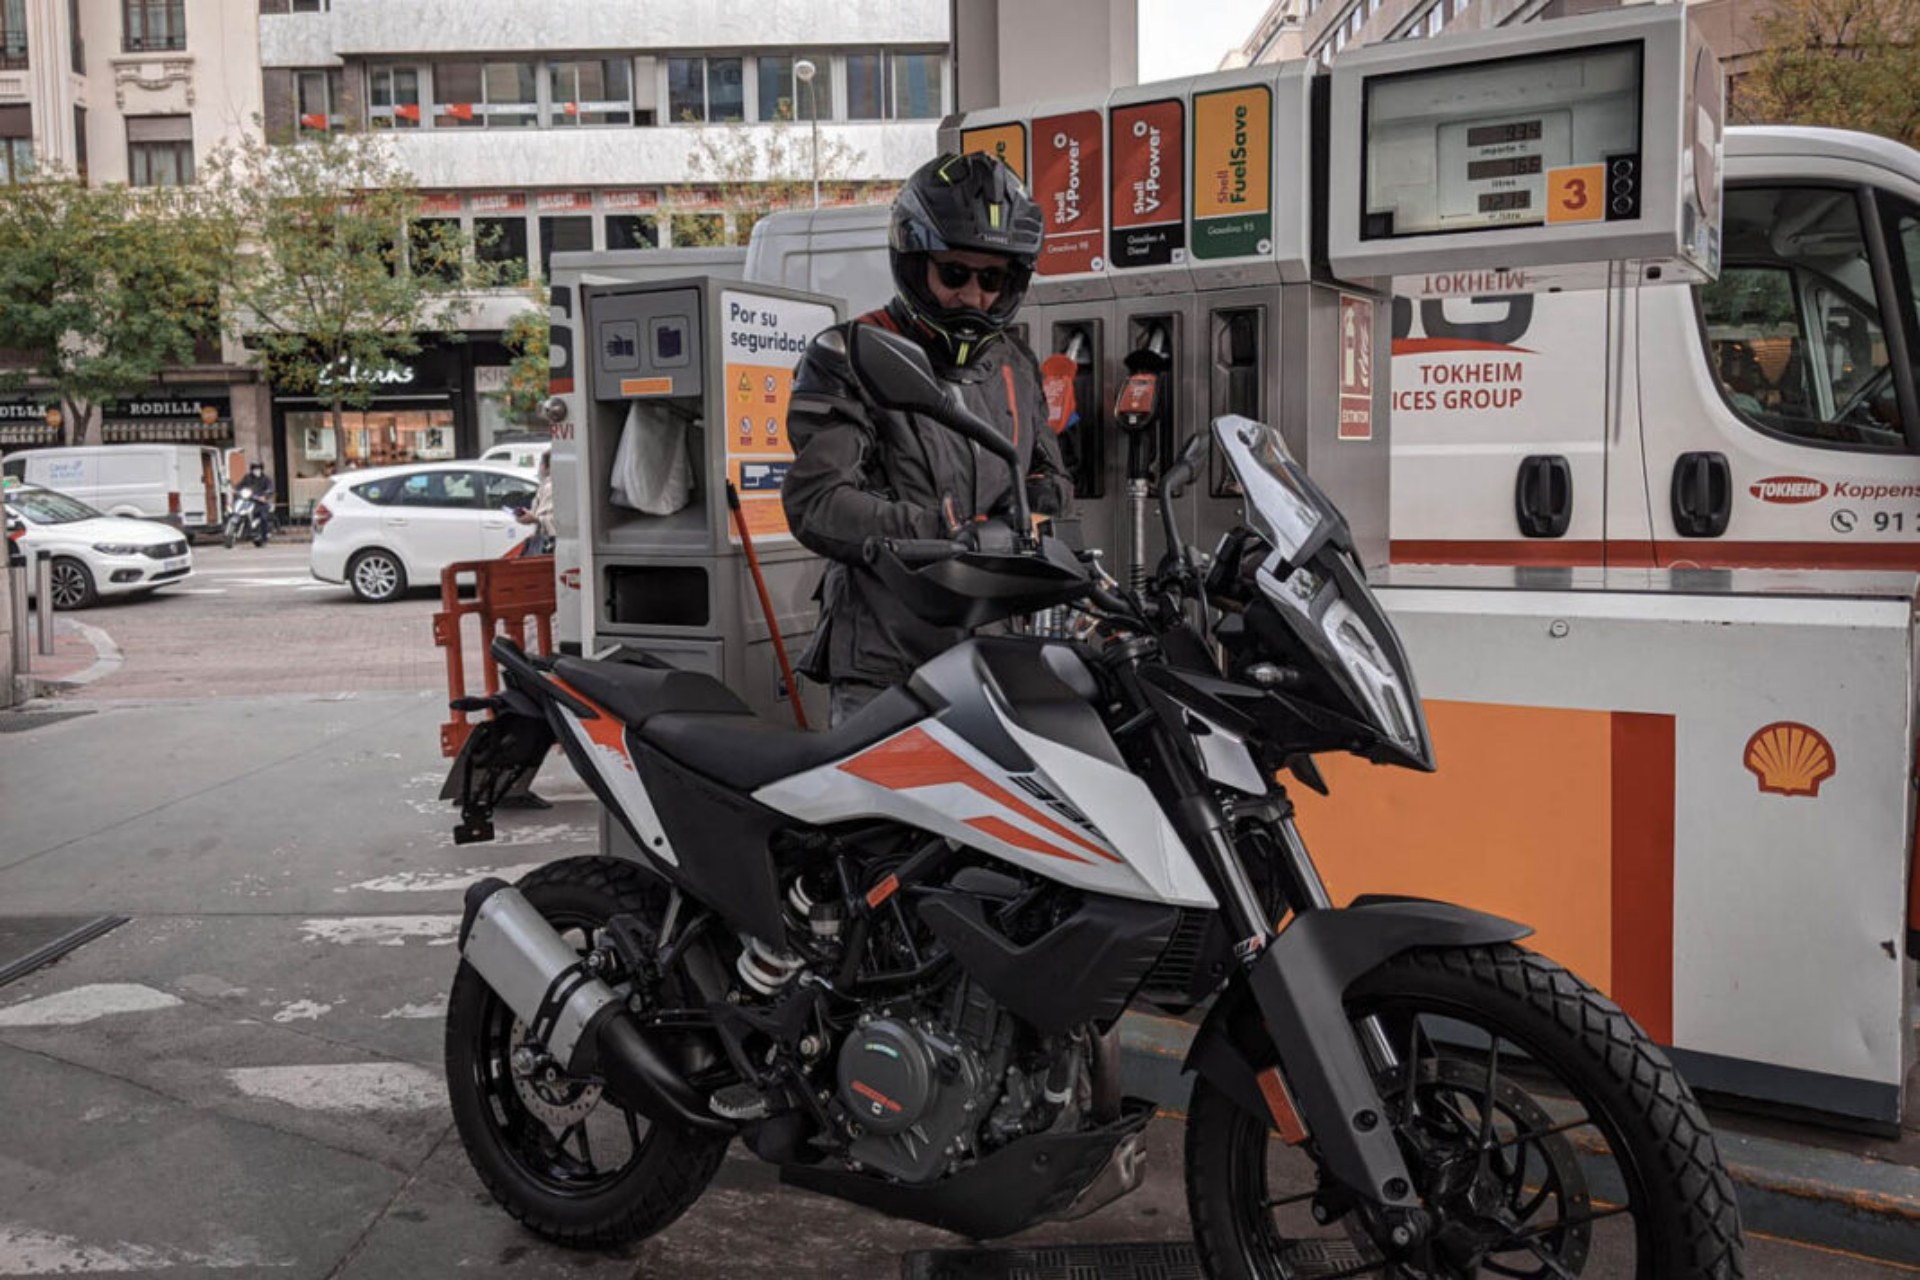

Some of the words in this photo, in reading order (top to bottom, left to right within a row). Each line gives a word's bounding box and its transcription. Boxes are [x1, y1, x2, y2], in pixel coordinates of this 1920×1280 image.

[1230, 104, 1247, 204] FuelSave
[1066, 138, 1080, 222] V-Power
[1145, 126, 1160, 213] V-Power
[1133, 181, 1145, 215] Shell
[1217, 170, 1229, 204] Shell
[1562, 178, 1588, 210] 3
[1054, 192, 1066, 224] Shell
[731, 302, 757, 323] Por
[761, 311, 778, 327] su
[731, 331, 806, 353] seguridad
[1420, 362, 1523, 385] TOKHEIM
[129, 402, 202, 415] RODILLA
[1443, 388, 1523, 410] GROUP
[1750, 482, 1821, 499] TOKHEIM
[1833, 482, 1920, 500] Koppens
[1874, 511, 1904, 532] 91
